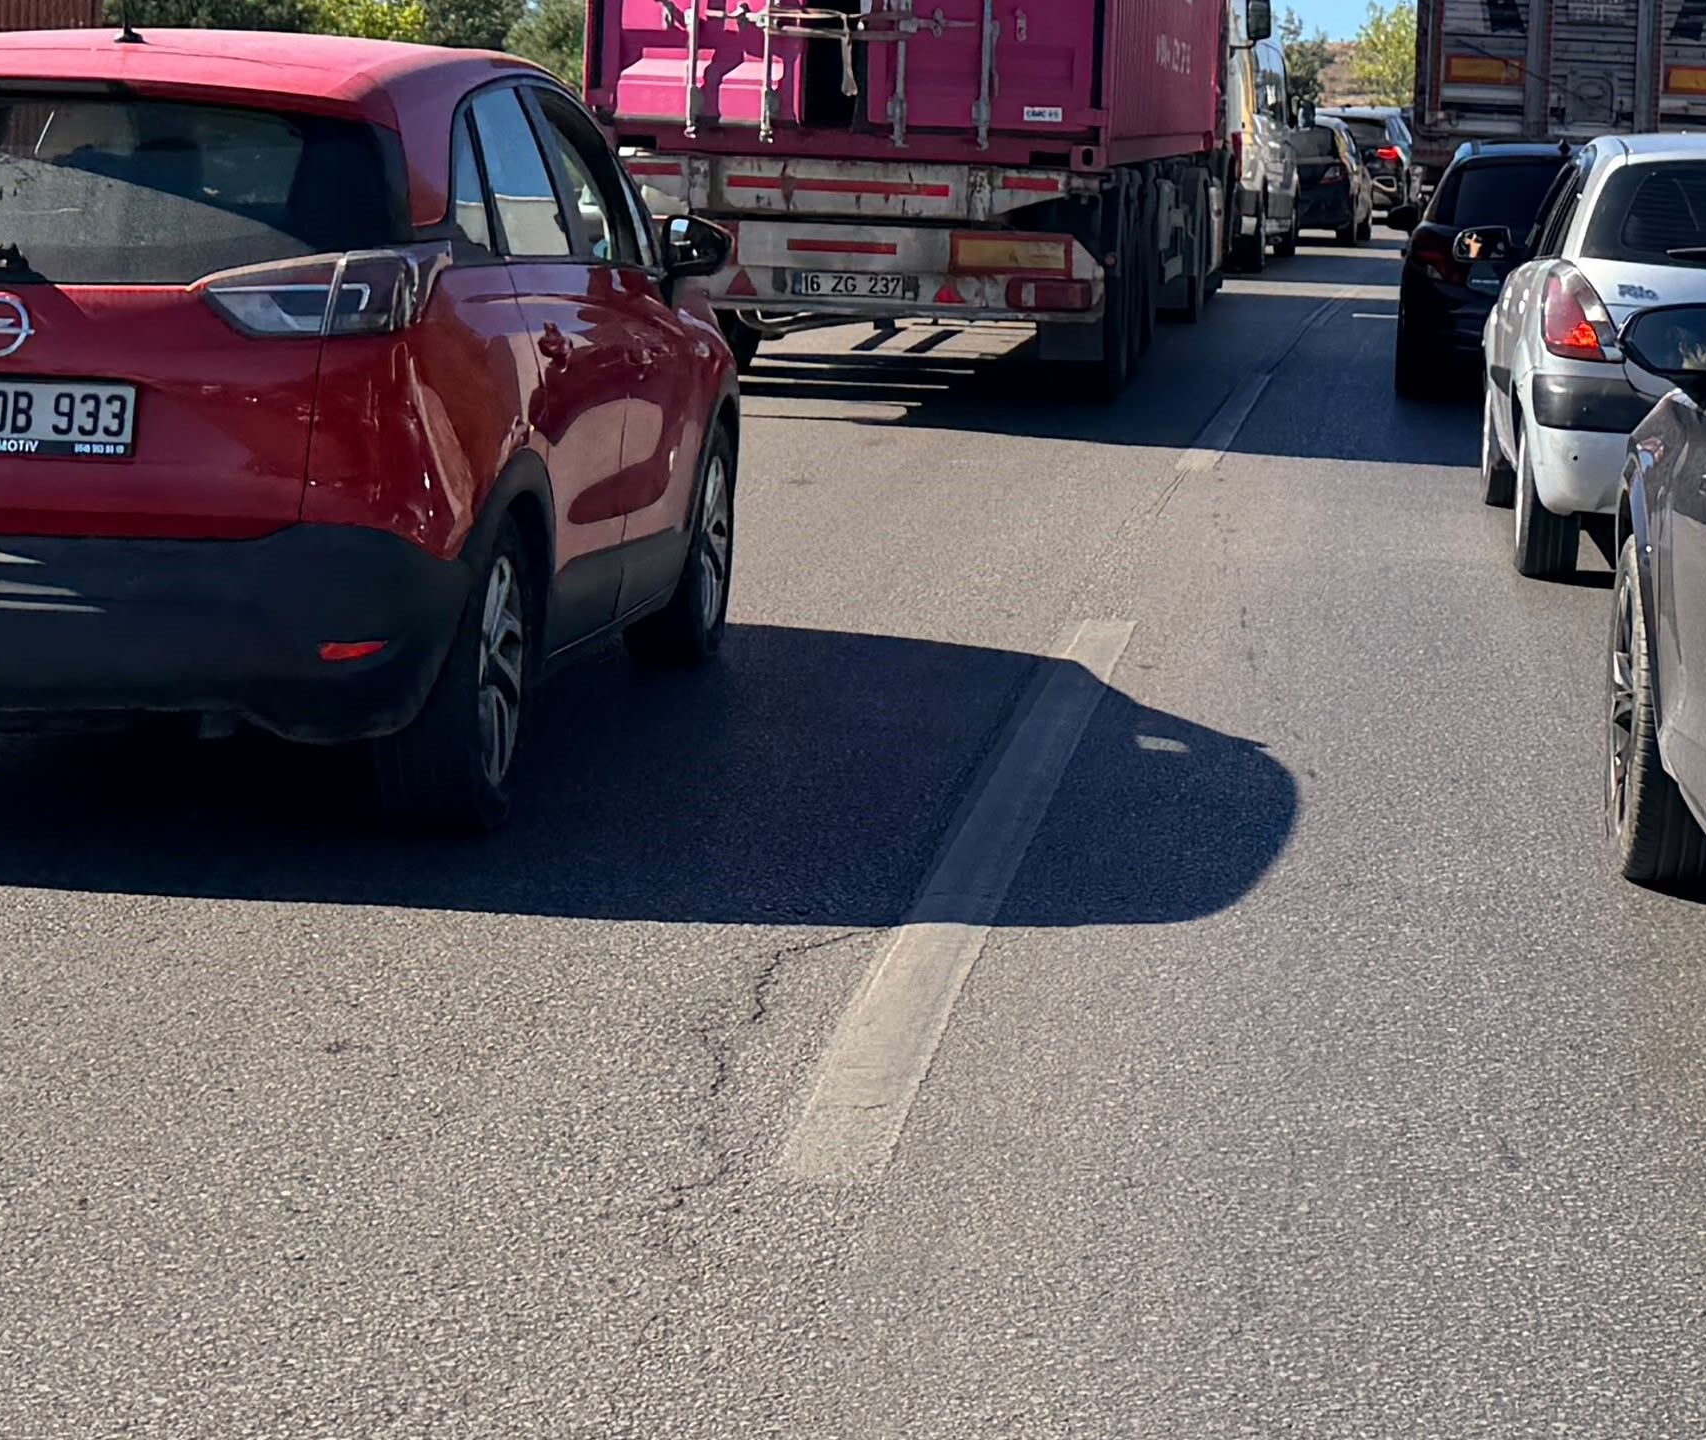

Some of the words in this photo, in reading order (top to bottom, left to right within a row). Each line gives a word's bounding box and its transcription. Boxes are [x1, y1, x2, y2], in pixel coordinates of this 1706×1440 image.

[804, 274, 821, 293] 16
[831, 275, 857, 293] ZG
[868, 276, 901, 295] 237
[51, 391, 128, 438] 933
